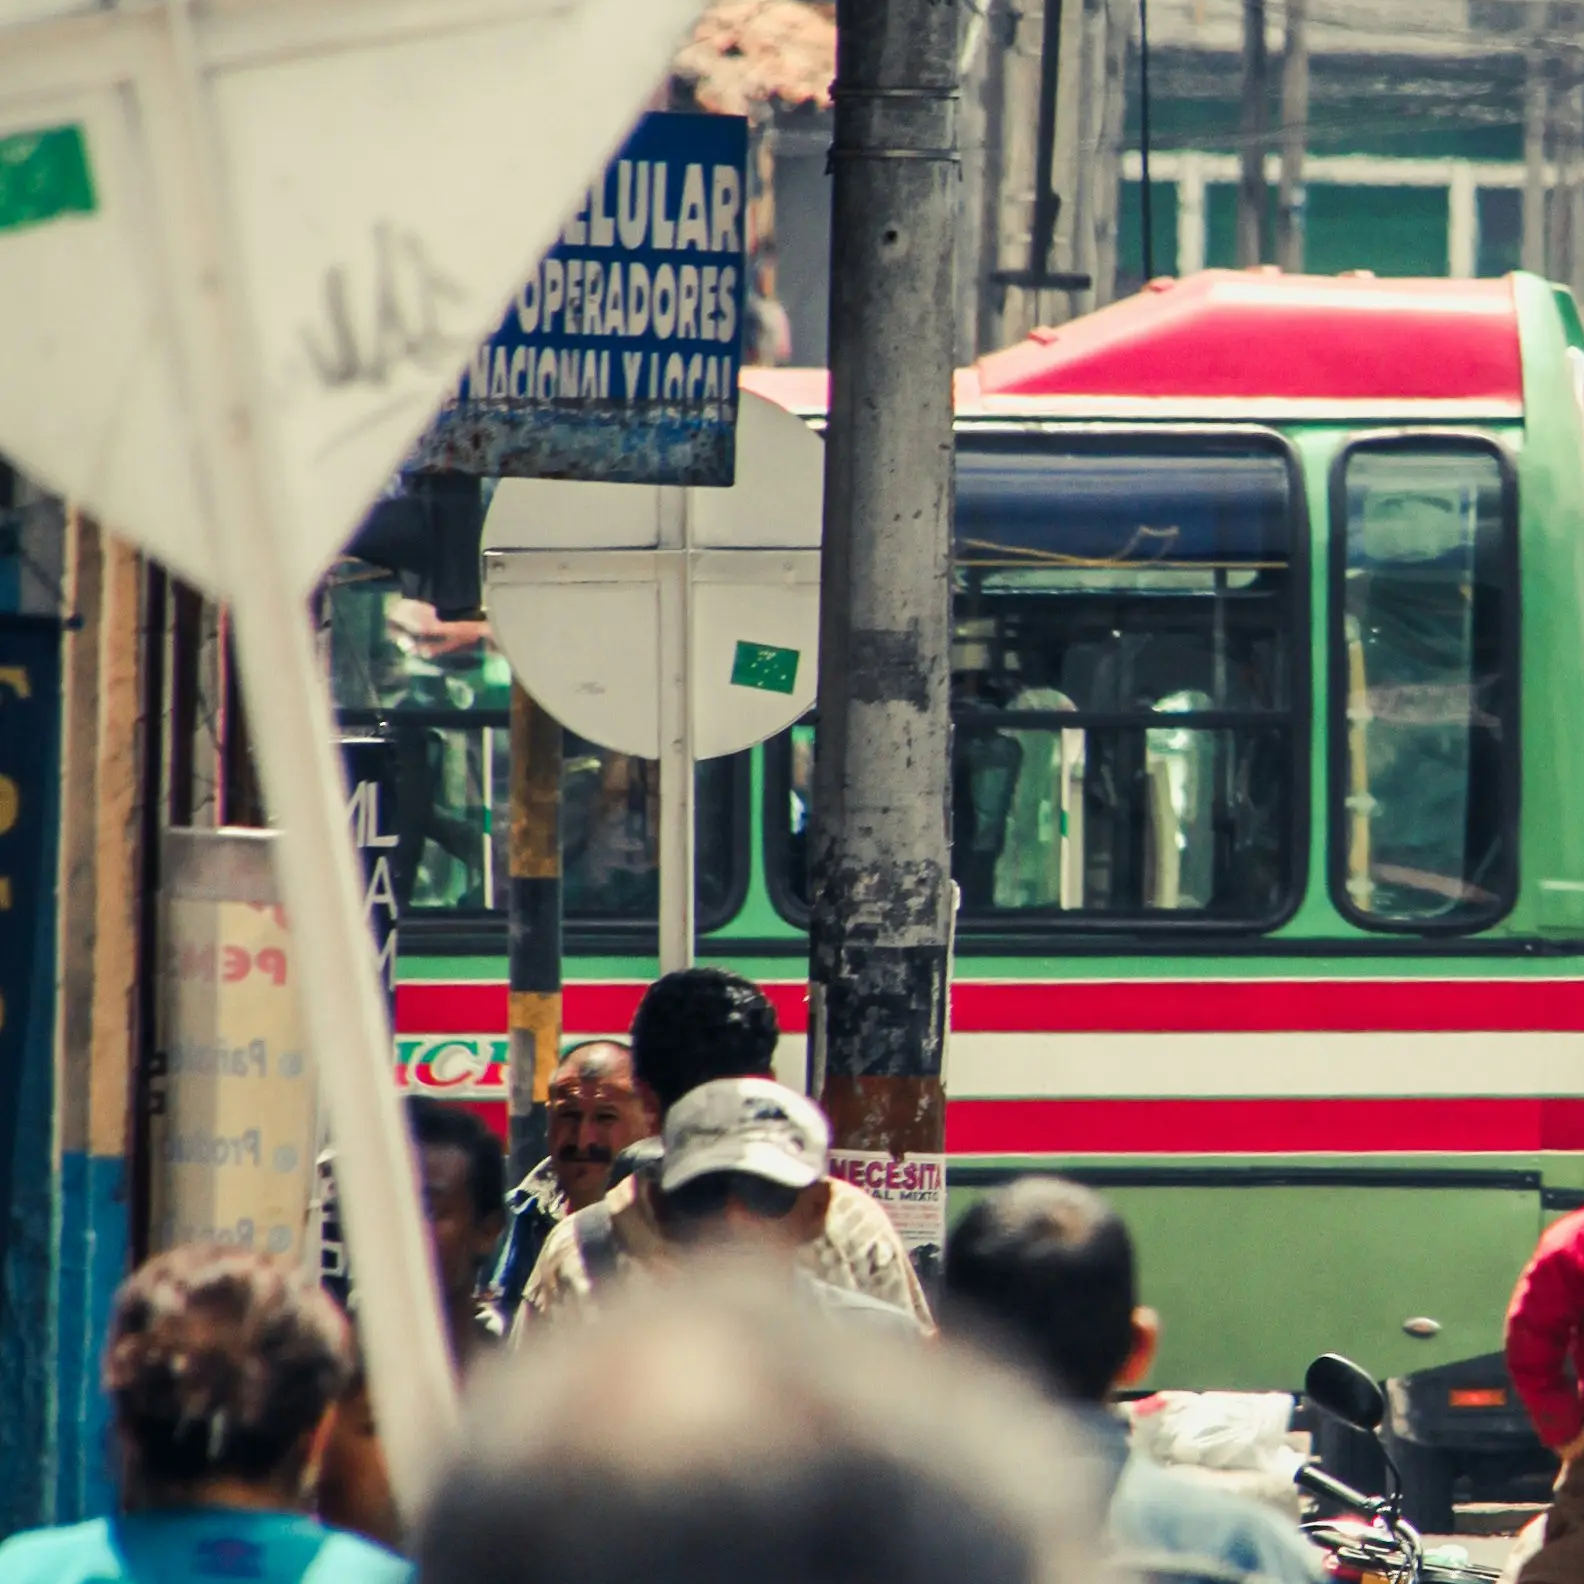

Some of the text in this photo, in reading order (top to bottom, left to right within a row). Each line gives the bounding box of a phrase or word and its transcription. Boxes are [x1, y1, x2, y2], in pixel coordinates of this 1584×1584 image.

[516, 259, 736, 343] OPERADORES
[467, 345, 733, 420] NACIONAL Y LOCAL
